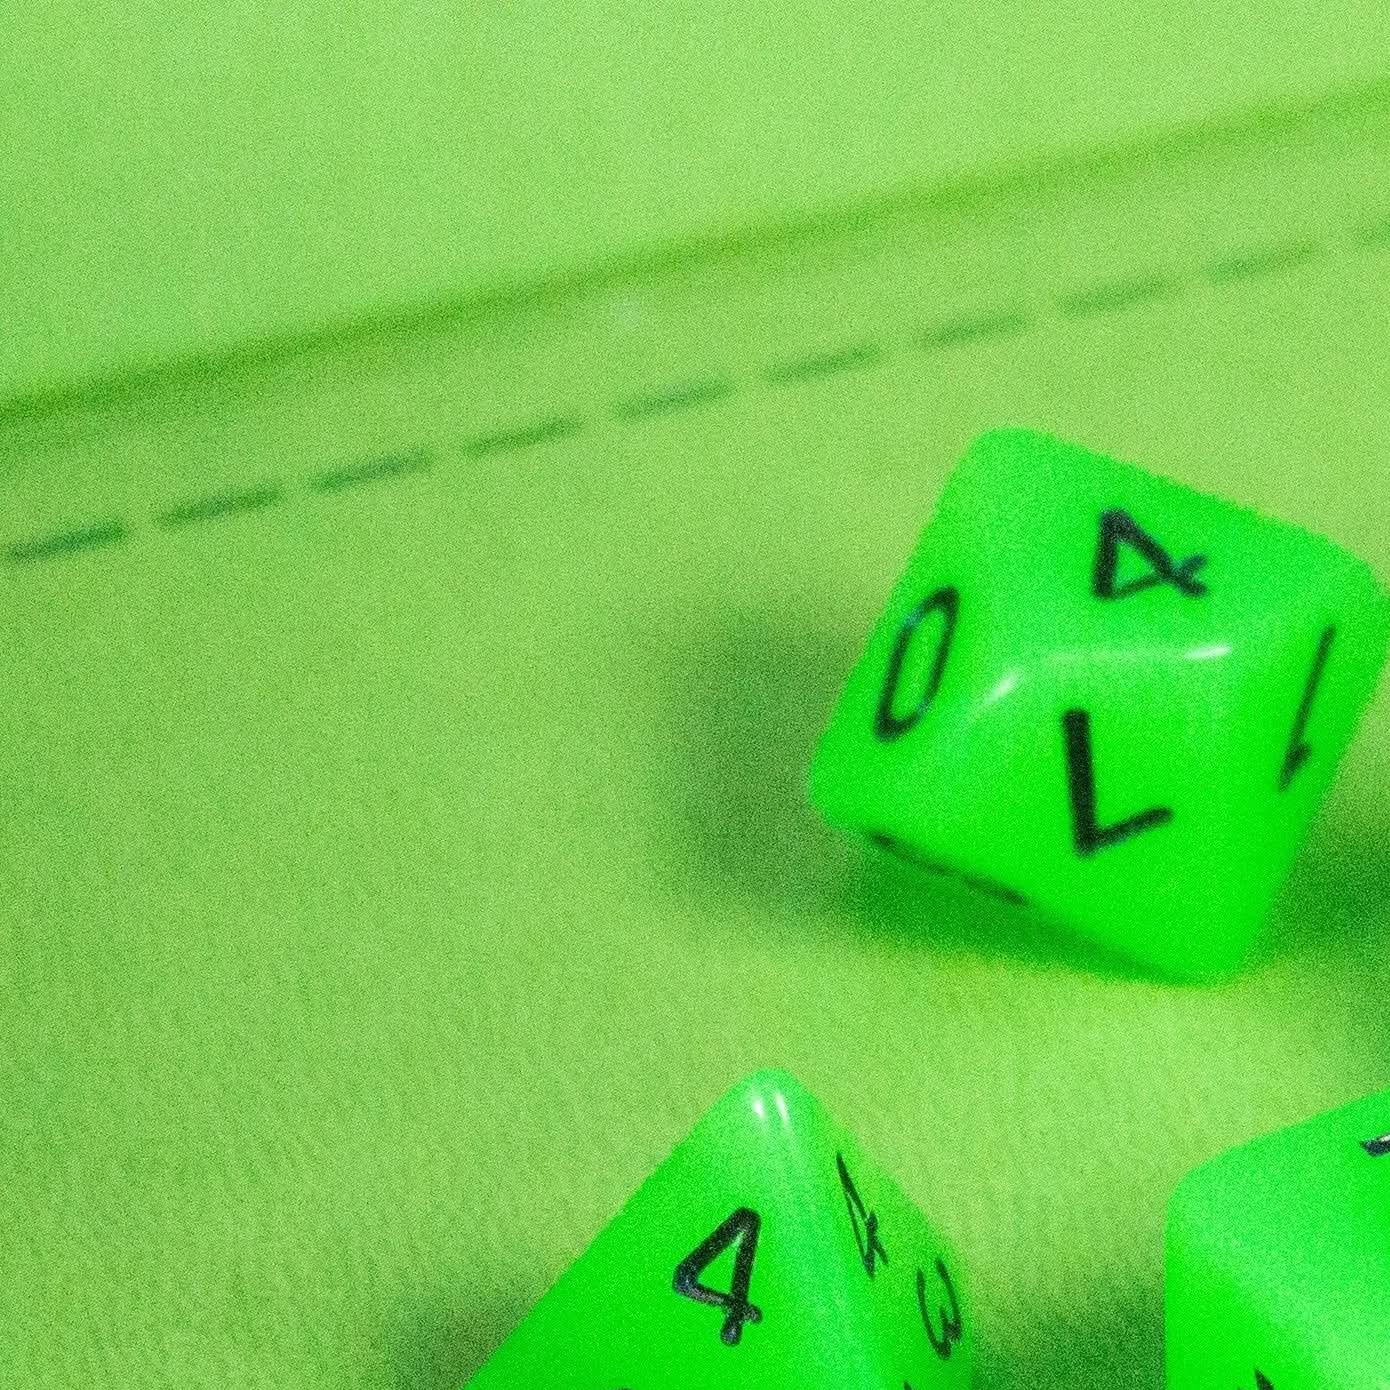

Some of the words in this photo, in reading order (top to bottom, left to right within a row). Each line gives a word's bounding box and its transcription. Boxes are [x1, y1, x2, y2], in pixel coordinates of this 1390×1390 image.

[1092, 509, 1206, 600] 4
[873, 586, 960, 742] 0
[673, 1207, 762, 1345] 4
